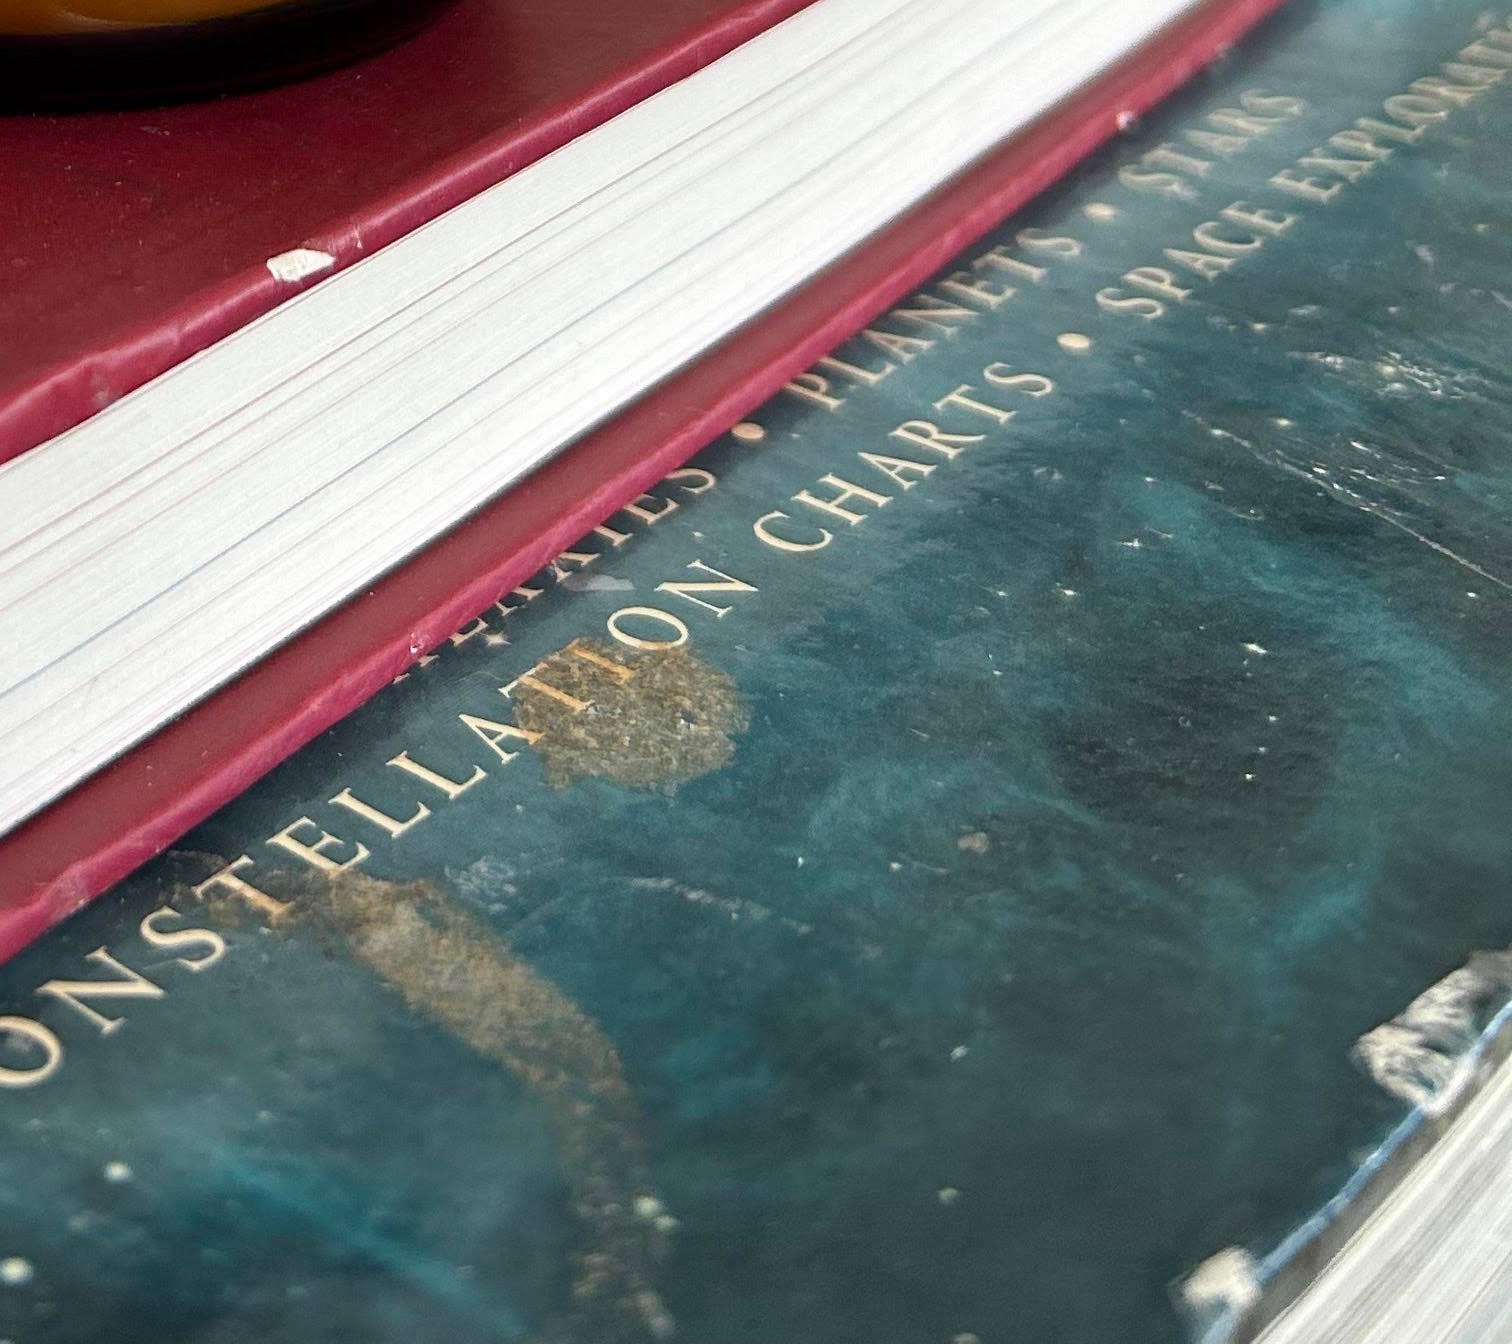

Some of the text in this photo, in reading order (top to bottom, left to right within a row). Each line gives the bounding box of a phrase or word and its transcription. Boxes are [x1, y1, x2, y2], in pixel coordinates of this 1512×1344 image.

[753, 362, 1055, 552] CHARTS
[1096, 200, 1299, 320] SPACE
[786, 89, 1307, 411] PLANETS STARS
